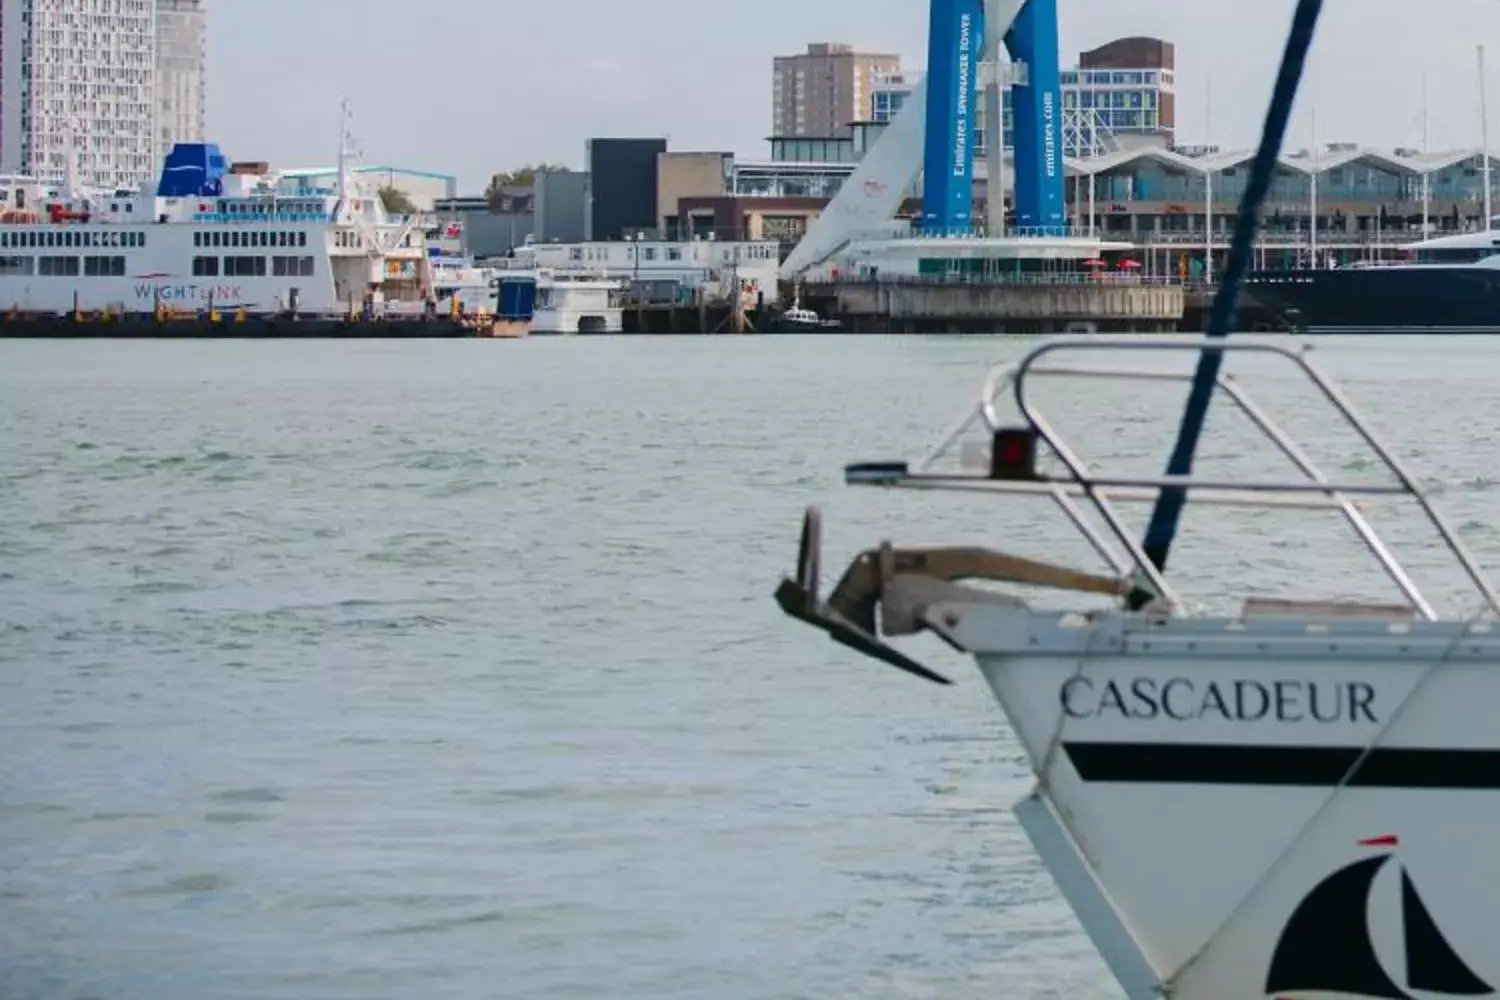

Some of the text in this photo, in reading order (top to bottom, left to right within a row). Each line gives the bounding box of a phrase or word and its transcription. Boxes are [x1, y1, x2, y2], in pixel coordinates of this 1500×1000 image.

[954, 119, 967, 177] Emirates
[1044, 91, 1055, 177] emirates.com
[1059, 675, 1379, 723] CASCADEUR
